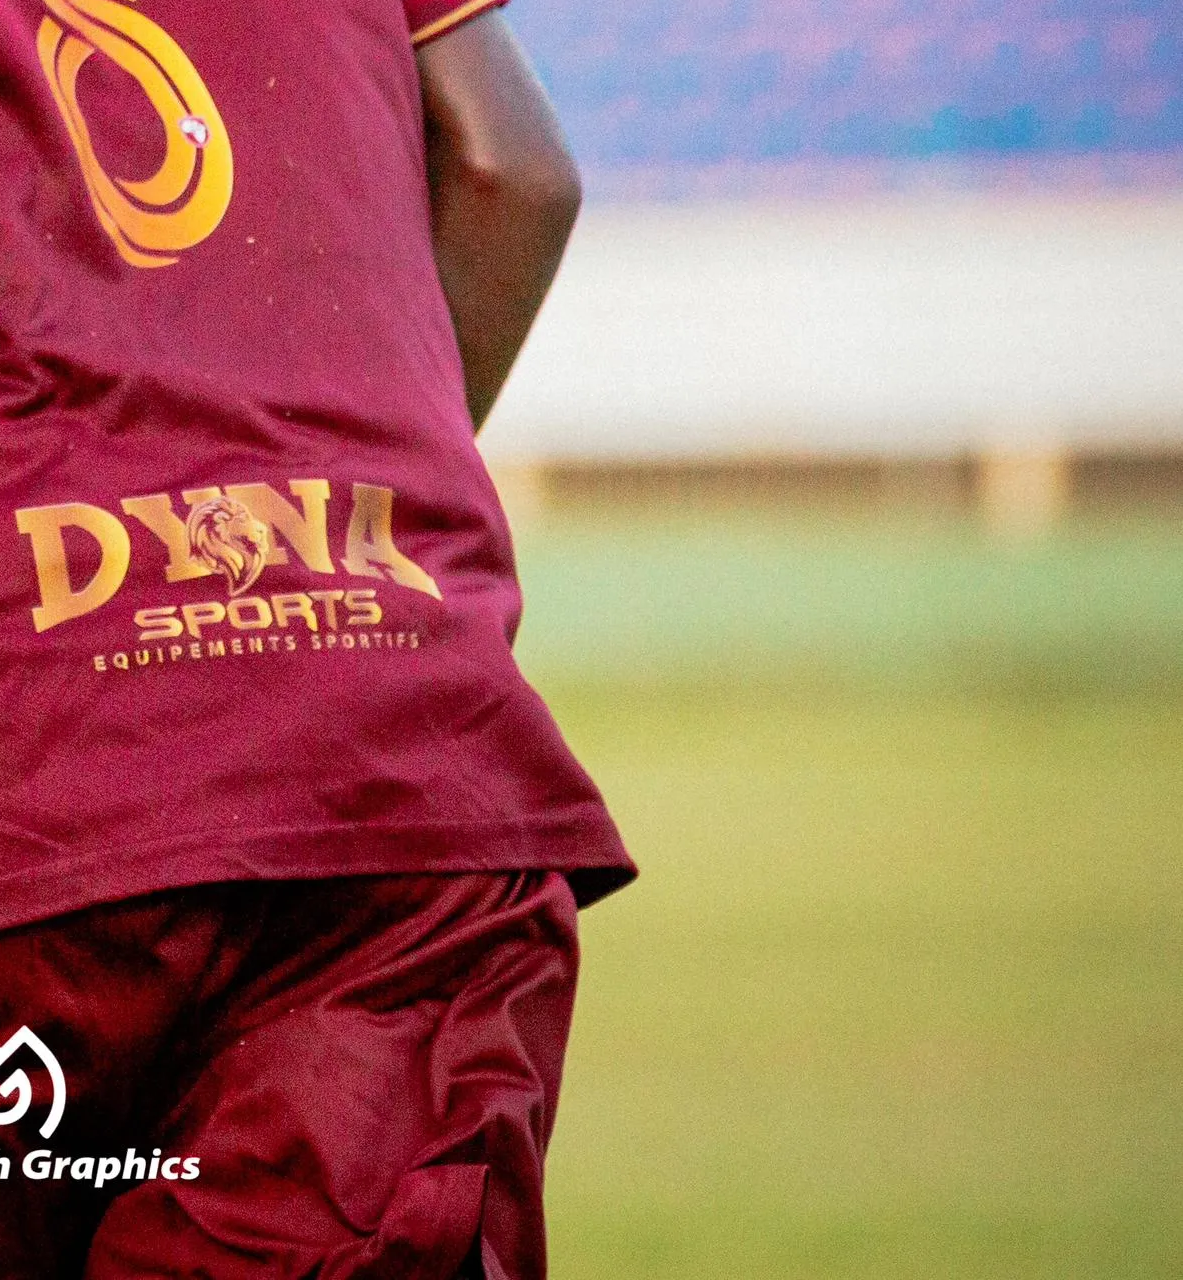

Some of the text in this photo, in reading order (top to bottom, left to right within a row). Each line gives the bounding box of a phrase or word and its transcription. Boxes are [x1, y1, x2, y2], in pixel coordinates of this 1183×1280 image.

[15, 479, 442, 633] DYNA
[134, 590, 382, 640] SPORTS
[94, 631, 419, 671] EQUIPEMENTS SPORTIFS
